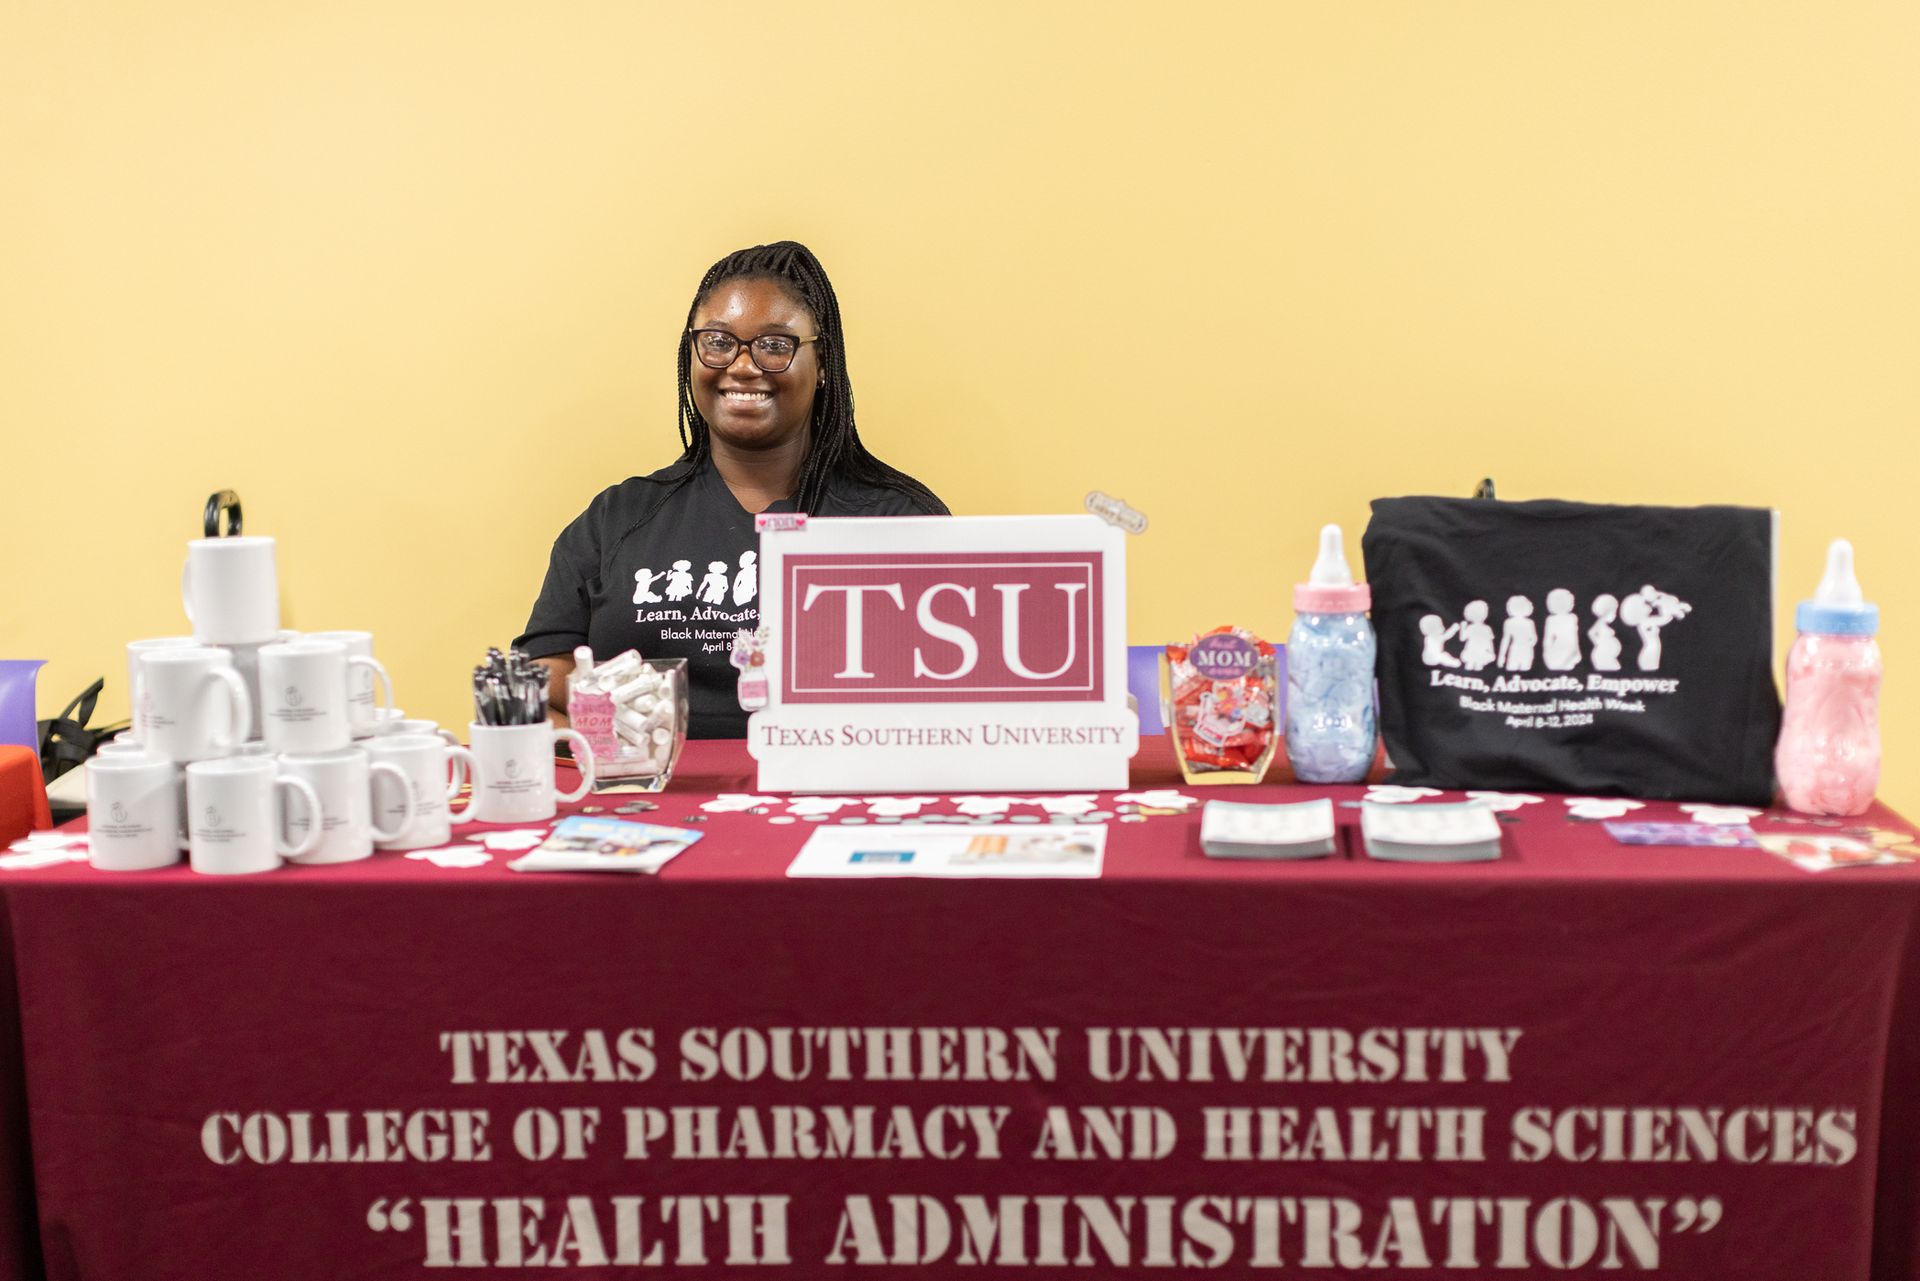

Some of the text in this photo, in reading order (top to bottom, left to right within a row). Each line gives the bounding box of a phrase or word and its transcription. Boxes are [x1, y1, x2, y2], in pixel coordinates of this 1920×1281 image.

[634, 606, 760, 623] Learn, Advocate,
[660, 627, 692, 641] Black
[802, 582, 1087, 681] TSU
[701, 640, 724, 655] April
[1197, 650, 1252, 667] MOM
[1430, 669, 1680, 698] Learn, Advocate, Empower
[1459, 695, 1646, 714] Black Maternal Health Week
[576, 716, 612, 727] MOM
[1505, 715, 1534, 728] April
[1563, 713, 1594, 727] 2024
[761, 724, 1126, 747] TEXAS SOUTHERN UNIVERSITY
[439, 1027, 1522, 1084] TEXAS SOUTHERN UNIVERSITY
[201, 1106, 1858, 1166] COLLEGE OF PHARMACY AND HEALTH SCIENCES
